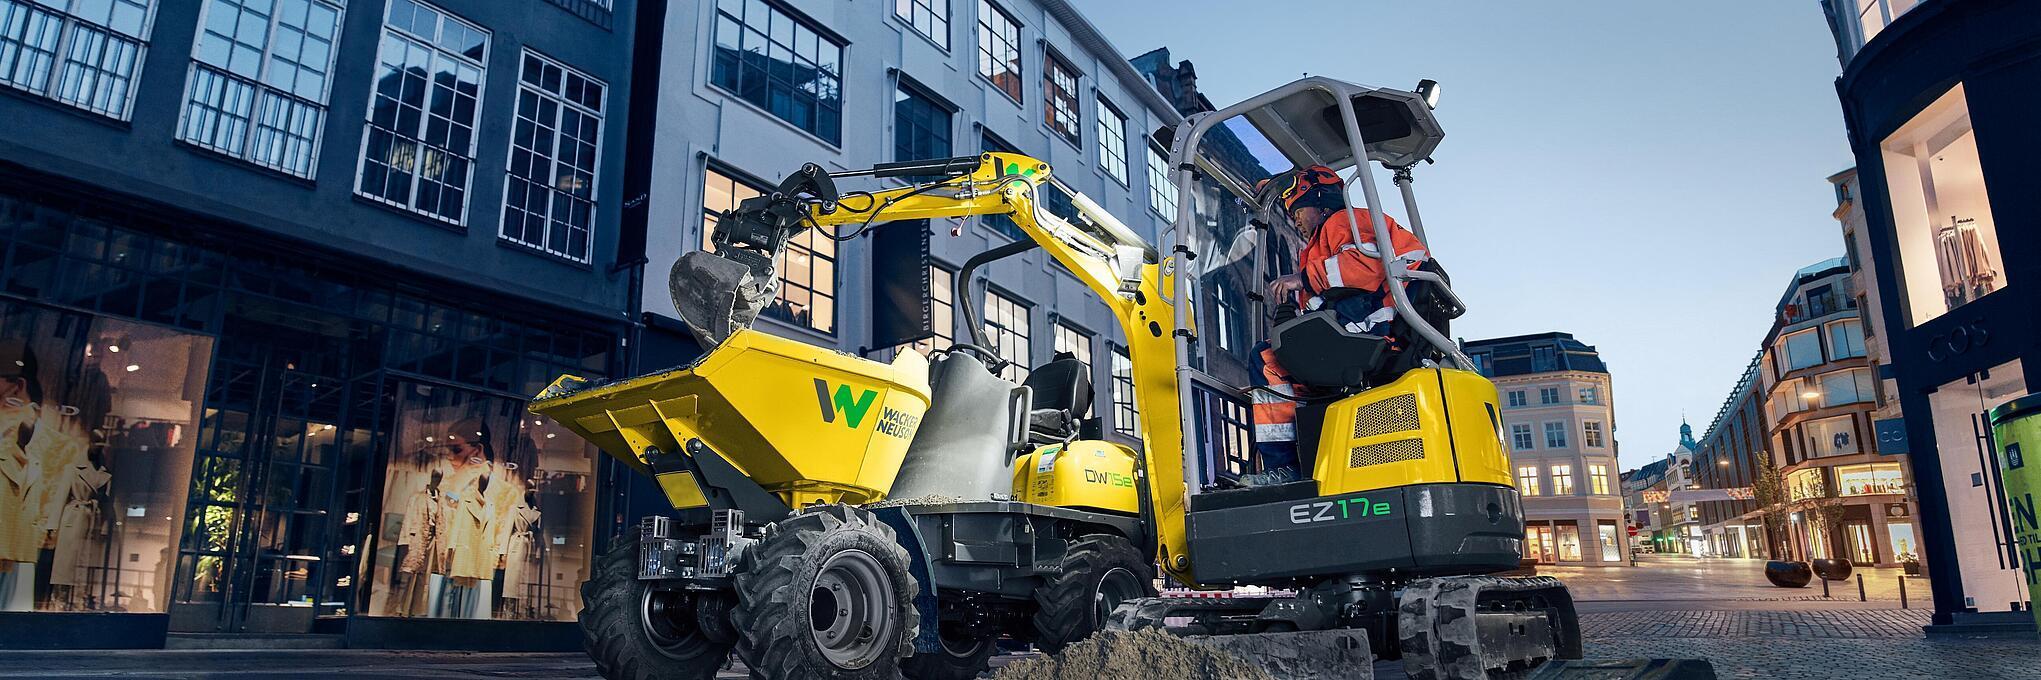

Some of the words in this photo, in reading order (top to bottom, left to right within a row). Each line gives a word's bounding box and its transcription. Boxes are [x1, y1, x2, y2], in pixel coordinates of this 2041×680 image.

[1927, 318, 1990, 362] COS
[883, 406, 919, 428] WACKER
[876, 419, 913, 440] NEUSON
[1880, 430, 1903, 443] CO
[1085, 468, 1133, 488] DW15e
[1289, 497, 1391, 524] EZ17e
[2009, 492, 2040, 534] N
